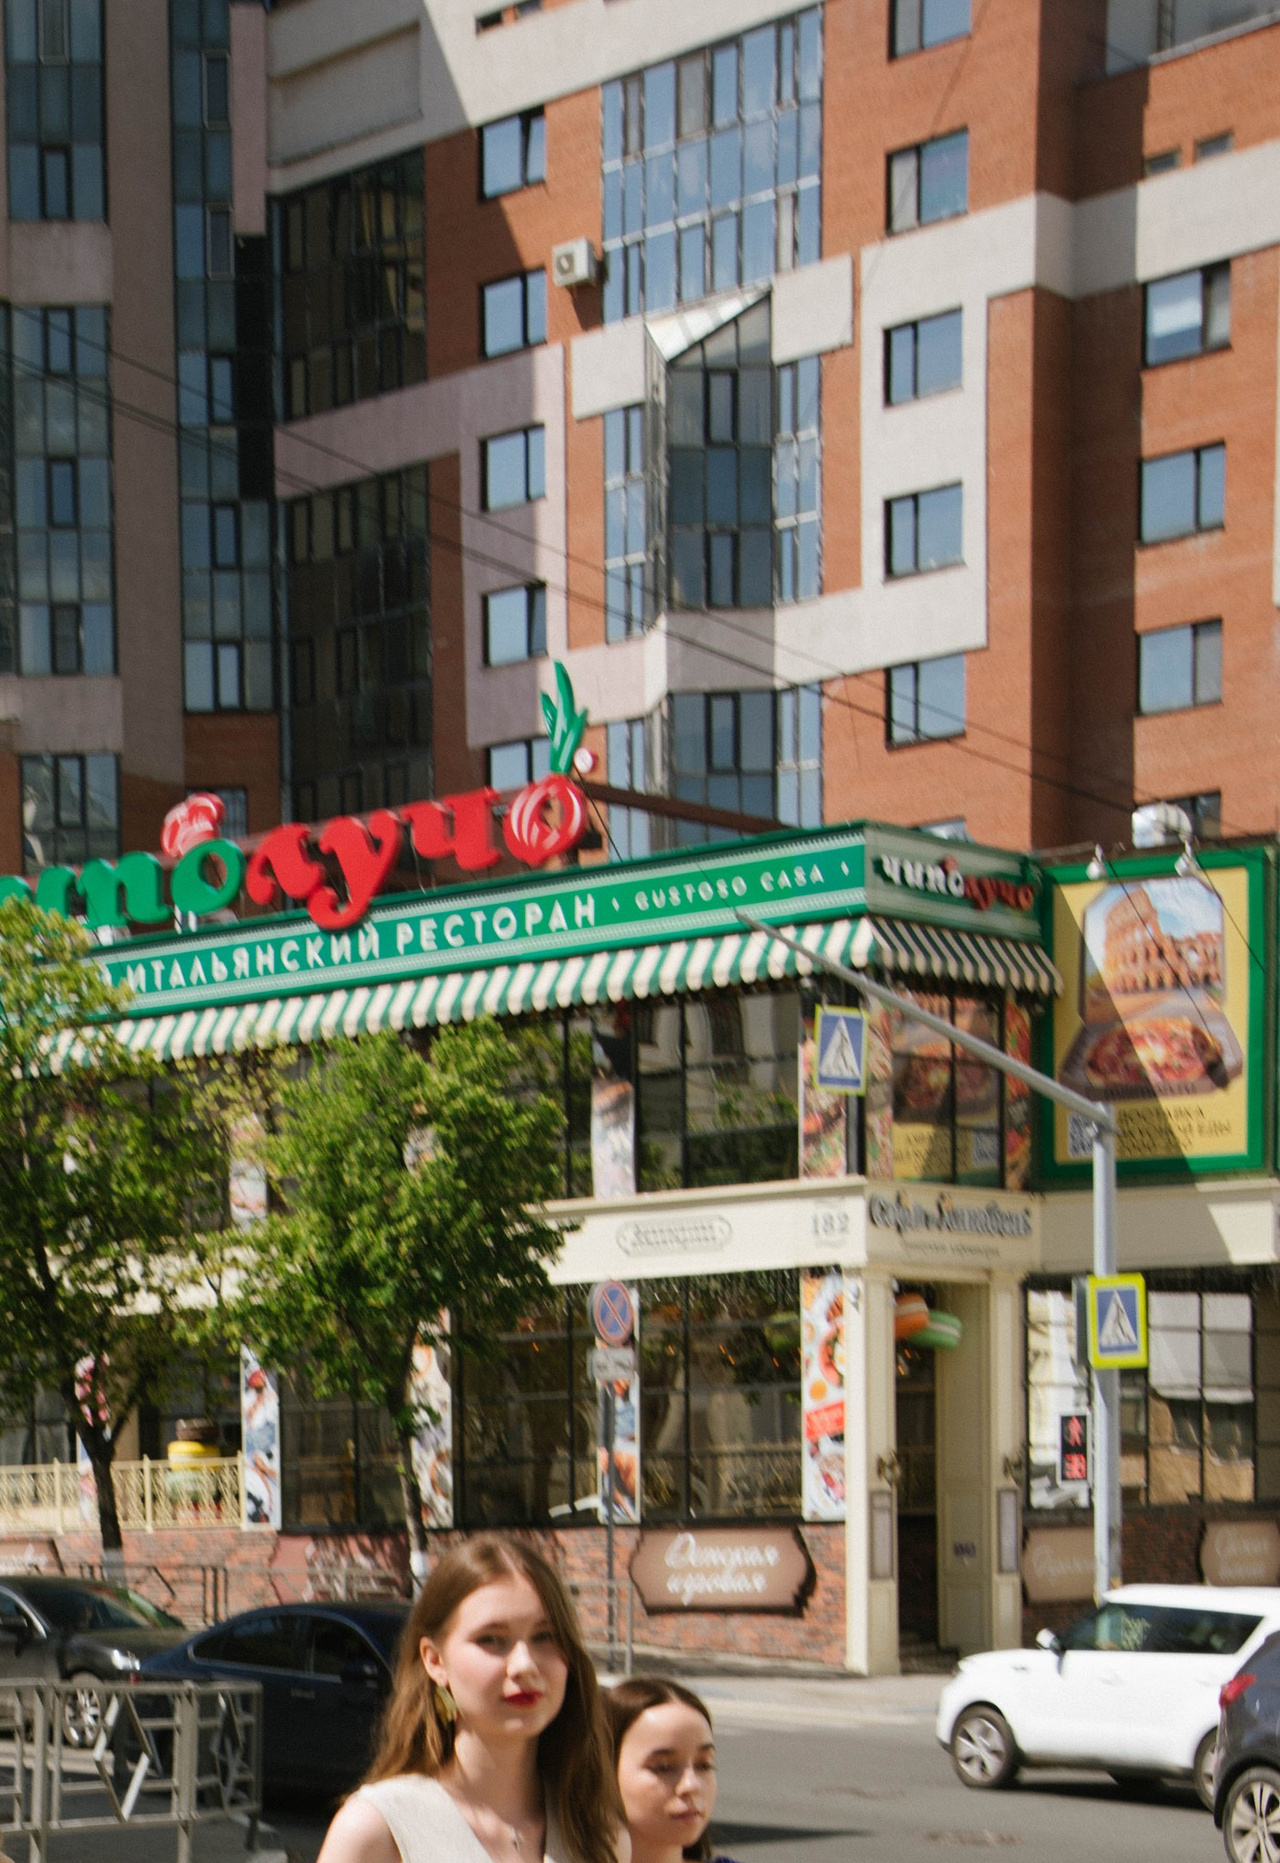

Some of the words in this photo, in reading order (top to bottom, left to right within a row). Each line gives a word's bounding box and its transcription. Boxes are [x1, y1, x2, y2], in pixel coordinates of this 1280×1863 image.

[760, 864, 824, 892] CASA
[125, 925, 380, 993] ИТАЛЬЯНСКИЙ
[396, 893, 595, 956] РЕСТОРАН
